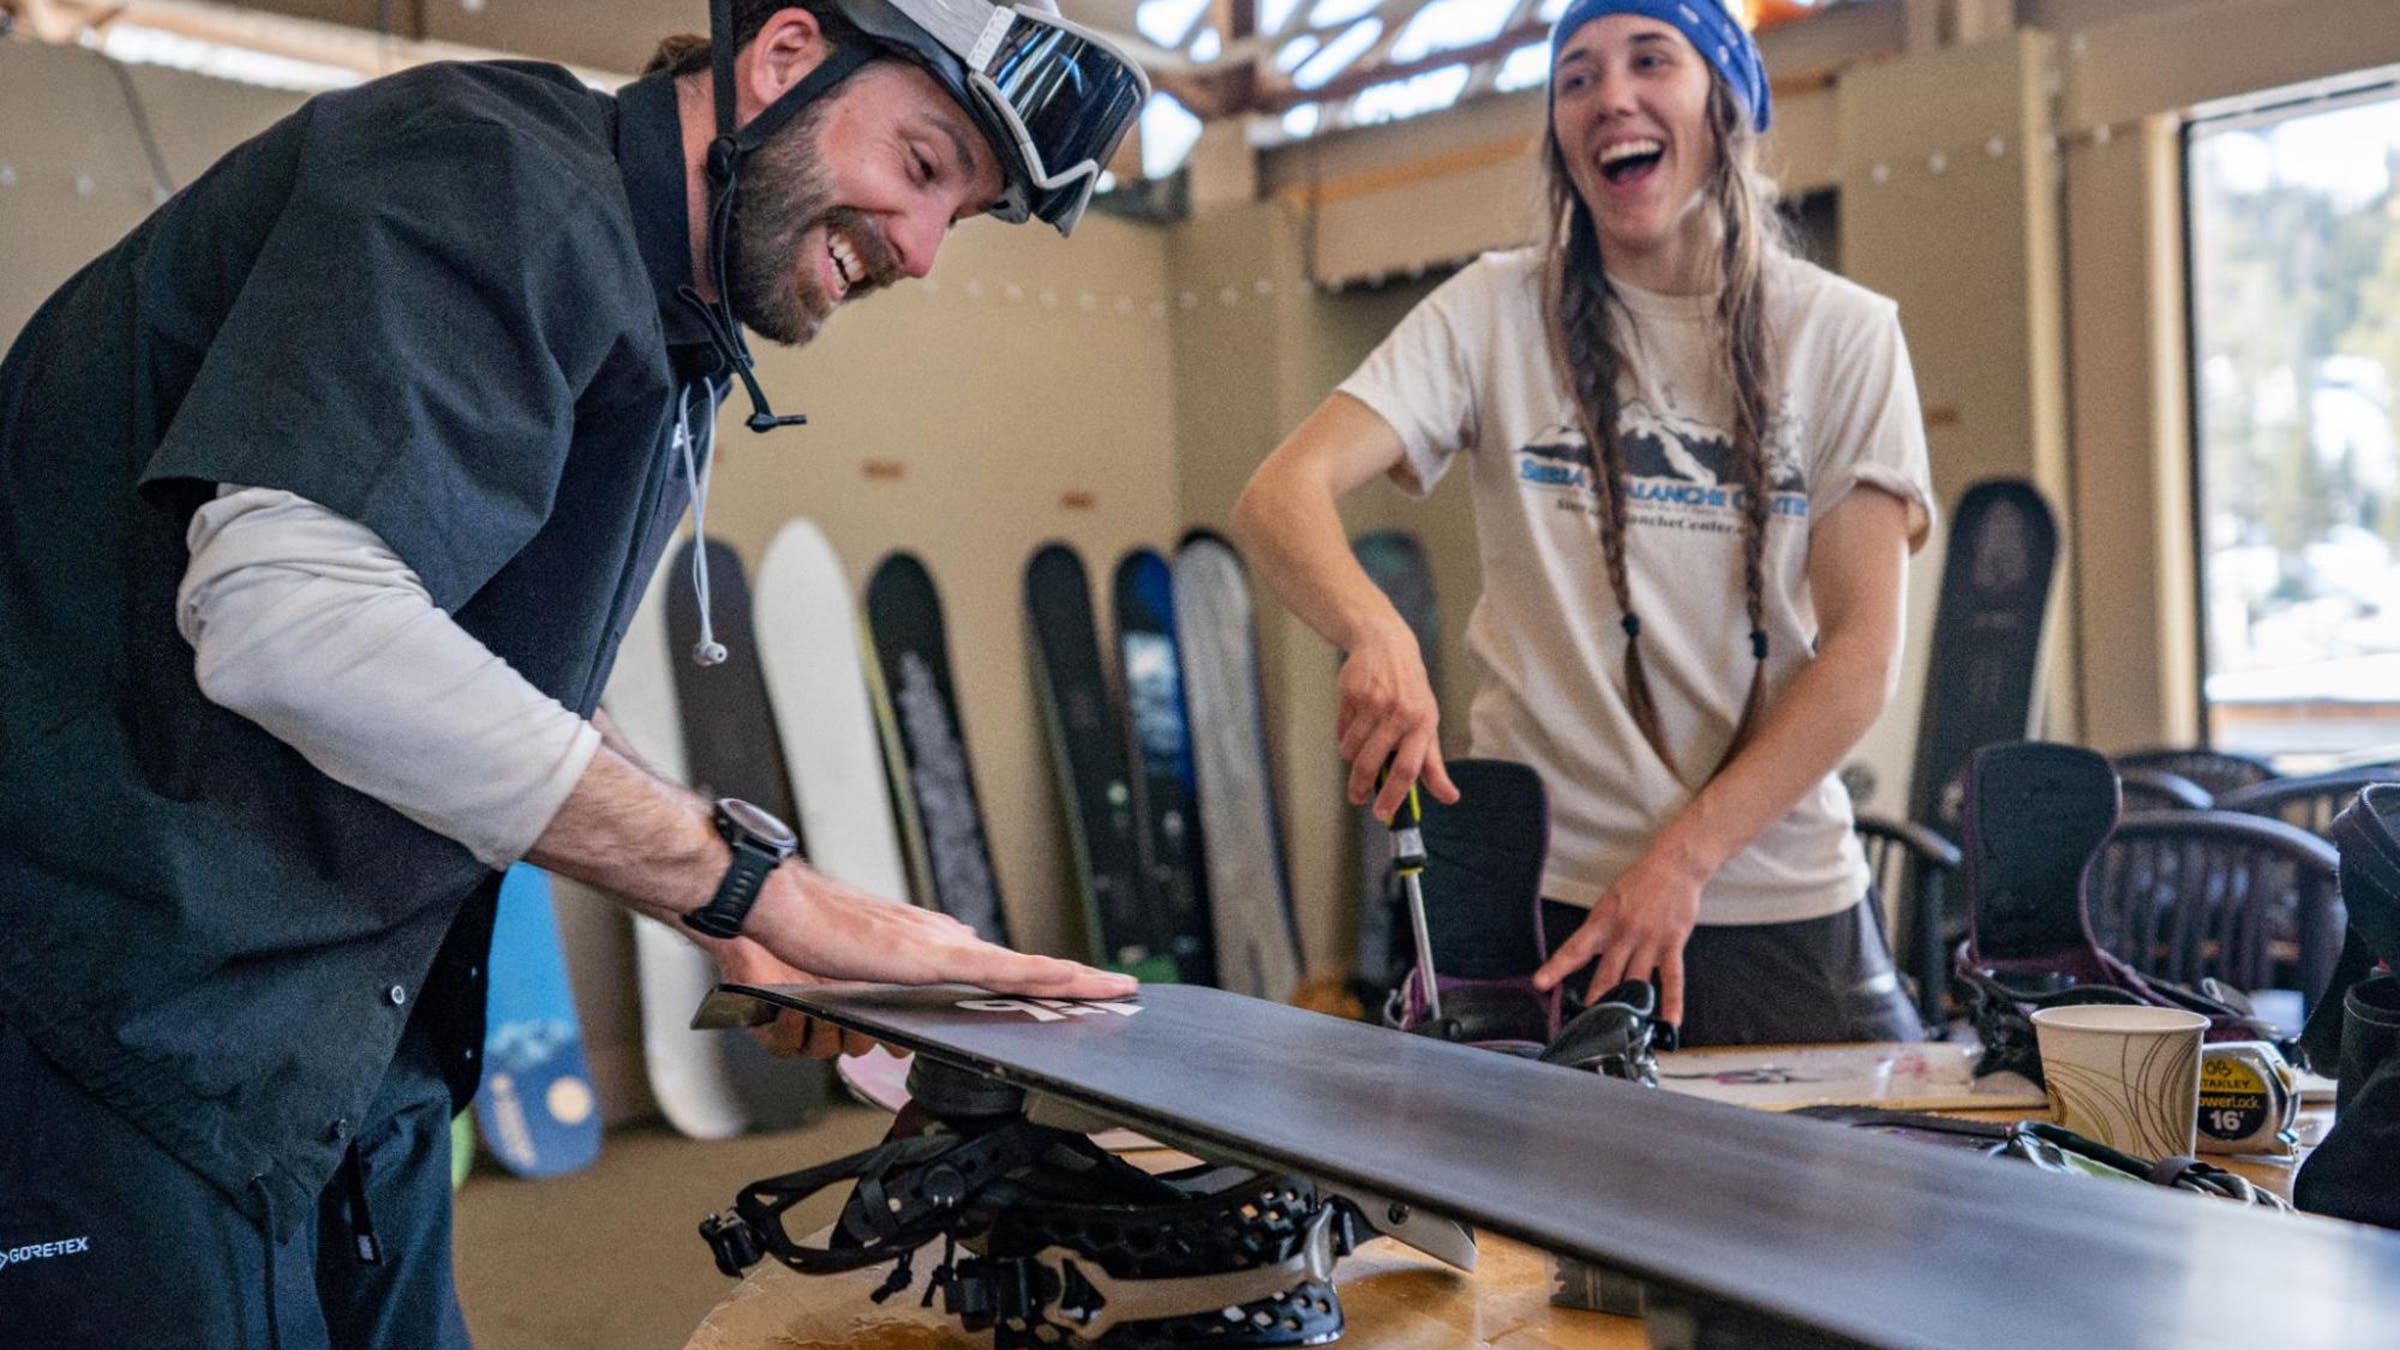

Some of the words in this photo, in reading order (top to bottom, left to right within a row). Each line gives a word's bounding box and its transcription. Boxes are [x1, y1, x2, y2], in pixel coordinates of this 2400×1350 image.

[2200, 1079, 2250, 1089] TANLEY
[2200, 1096, 2260, 1108] owerLock
[2209, 1110, 2244, 1131] 16'
[9, 1236, 89, 1263] GORE-TEX
